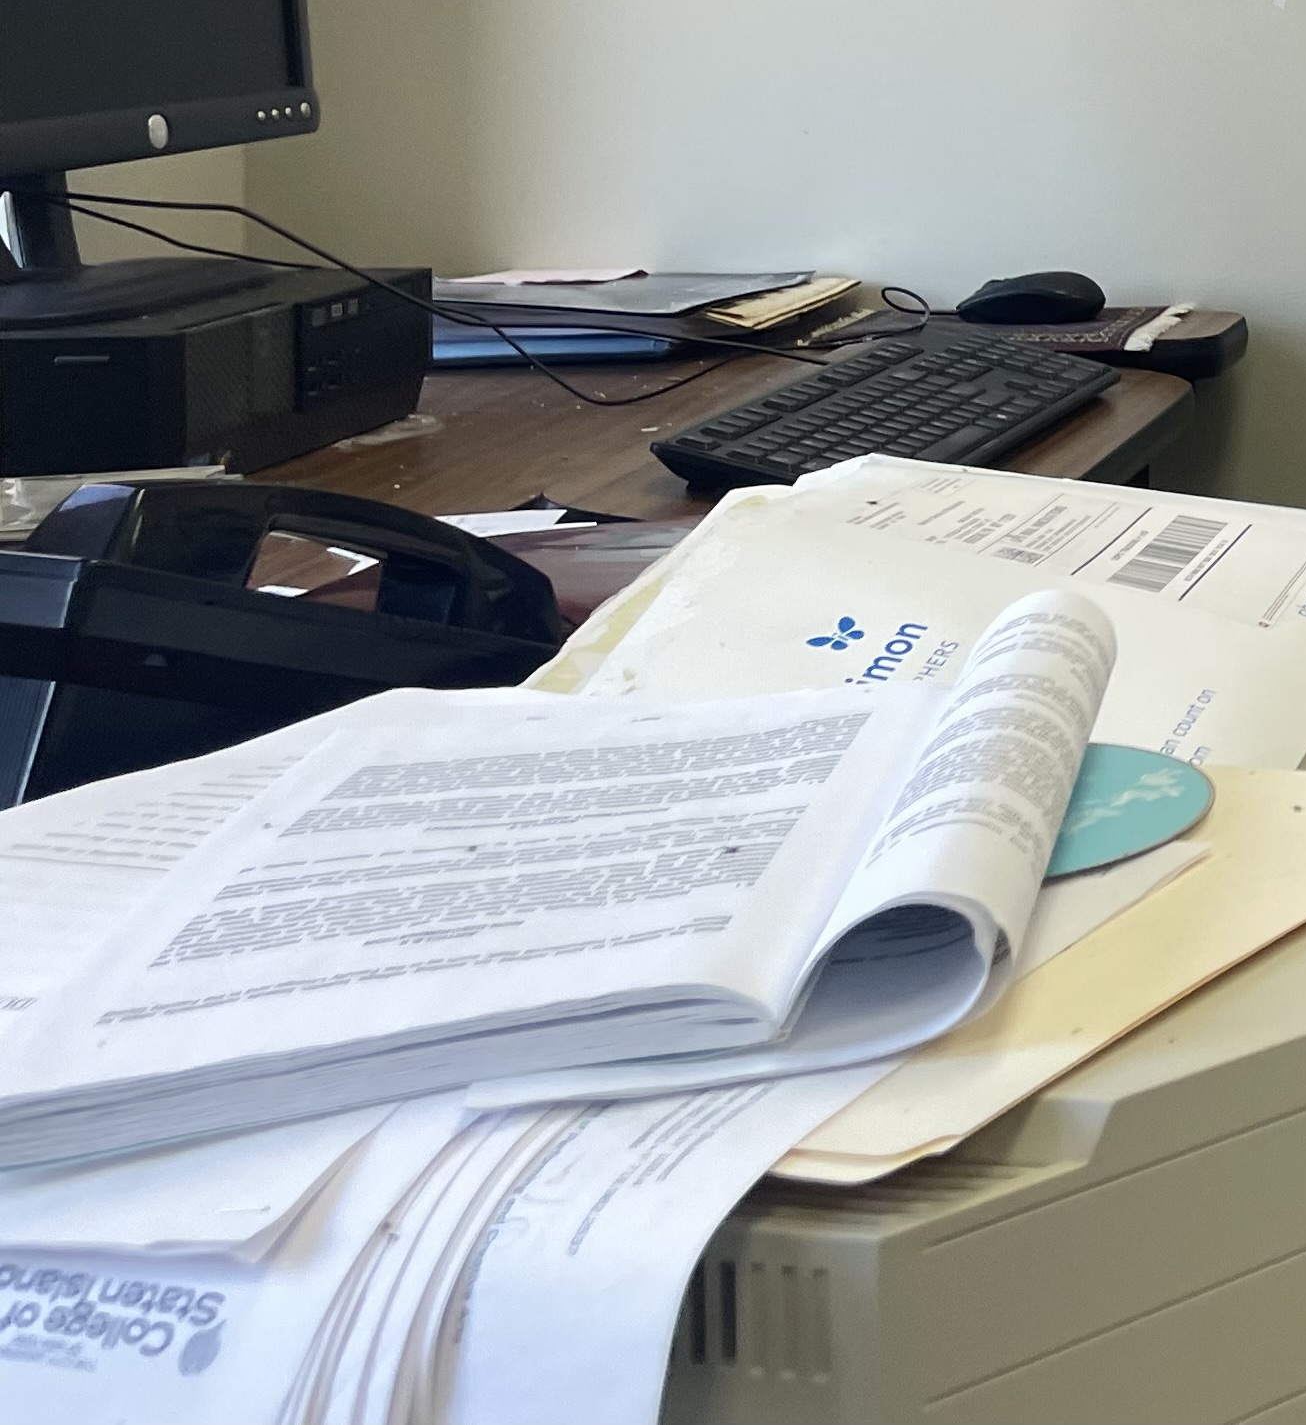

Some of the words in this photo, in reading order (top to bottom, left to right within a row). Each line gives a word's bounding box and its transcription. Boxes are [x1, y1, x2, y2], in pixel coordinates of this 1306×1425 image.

[1172, 702, 1207, 738] count
[1196, 687, 1217, 705] on
[99, 1276, 228, 1327] Staten
[44, 1301, 176, 1358] College
